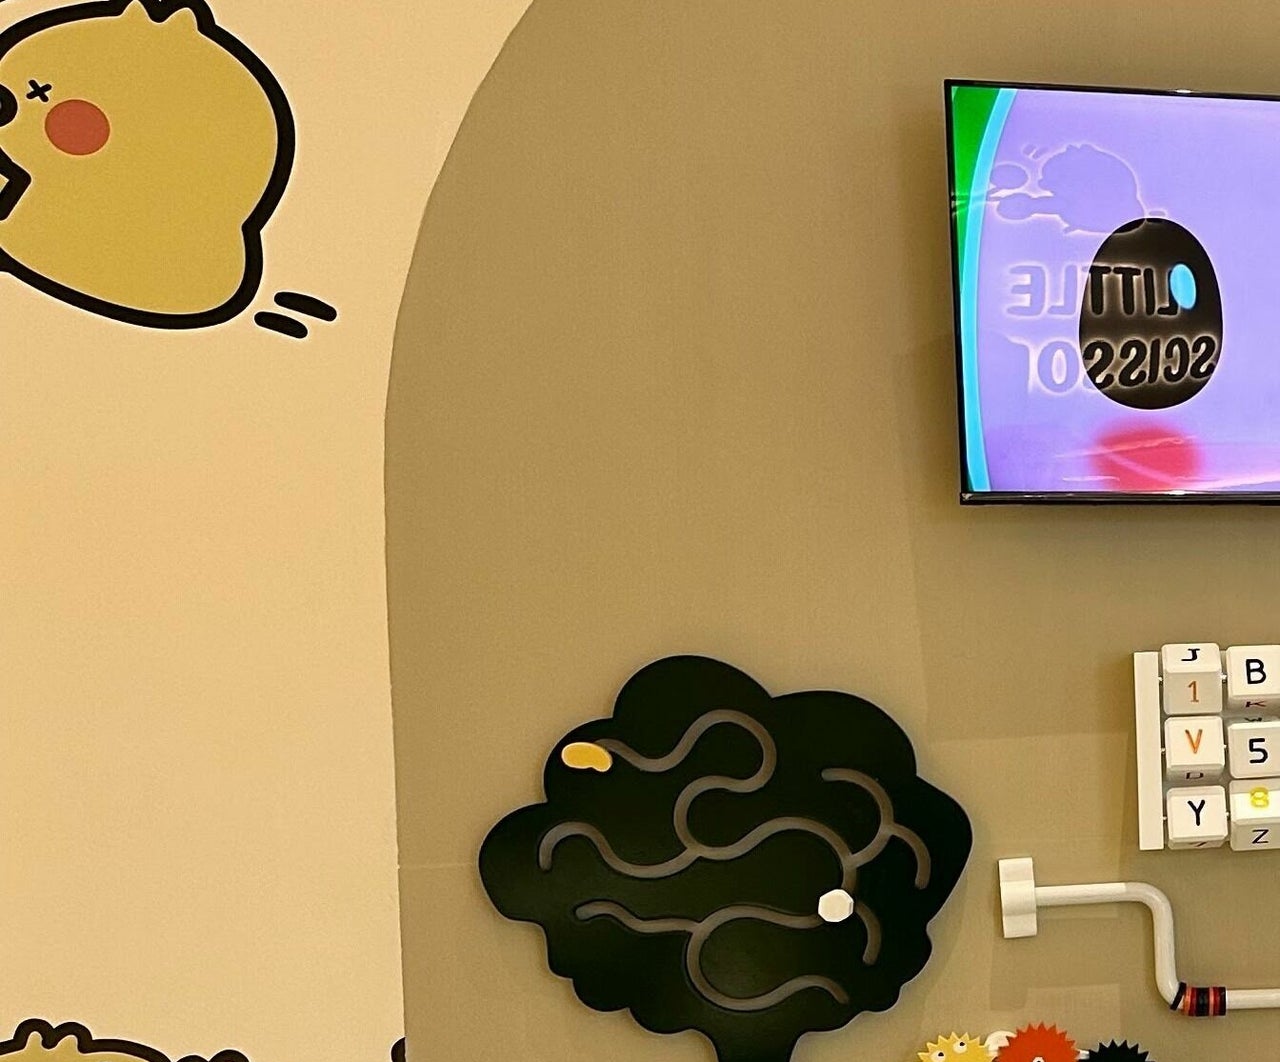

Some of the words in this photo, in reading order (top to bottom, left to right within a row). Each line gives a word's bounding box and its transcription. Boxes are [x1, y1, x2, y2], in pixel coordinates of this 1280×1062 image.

[1245, 658, 1267, 685] B
[1185, 729, 1203, 754] V
[1249, 737, 1269, 764] 5
[1250, 786, 1269, 808] 8
[1187, 799, 1206, 826] Y
